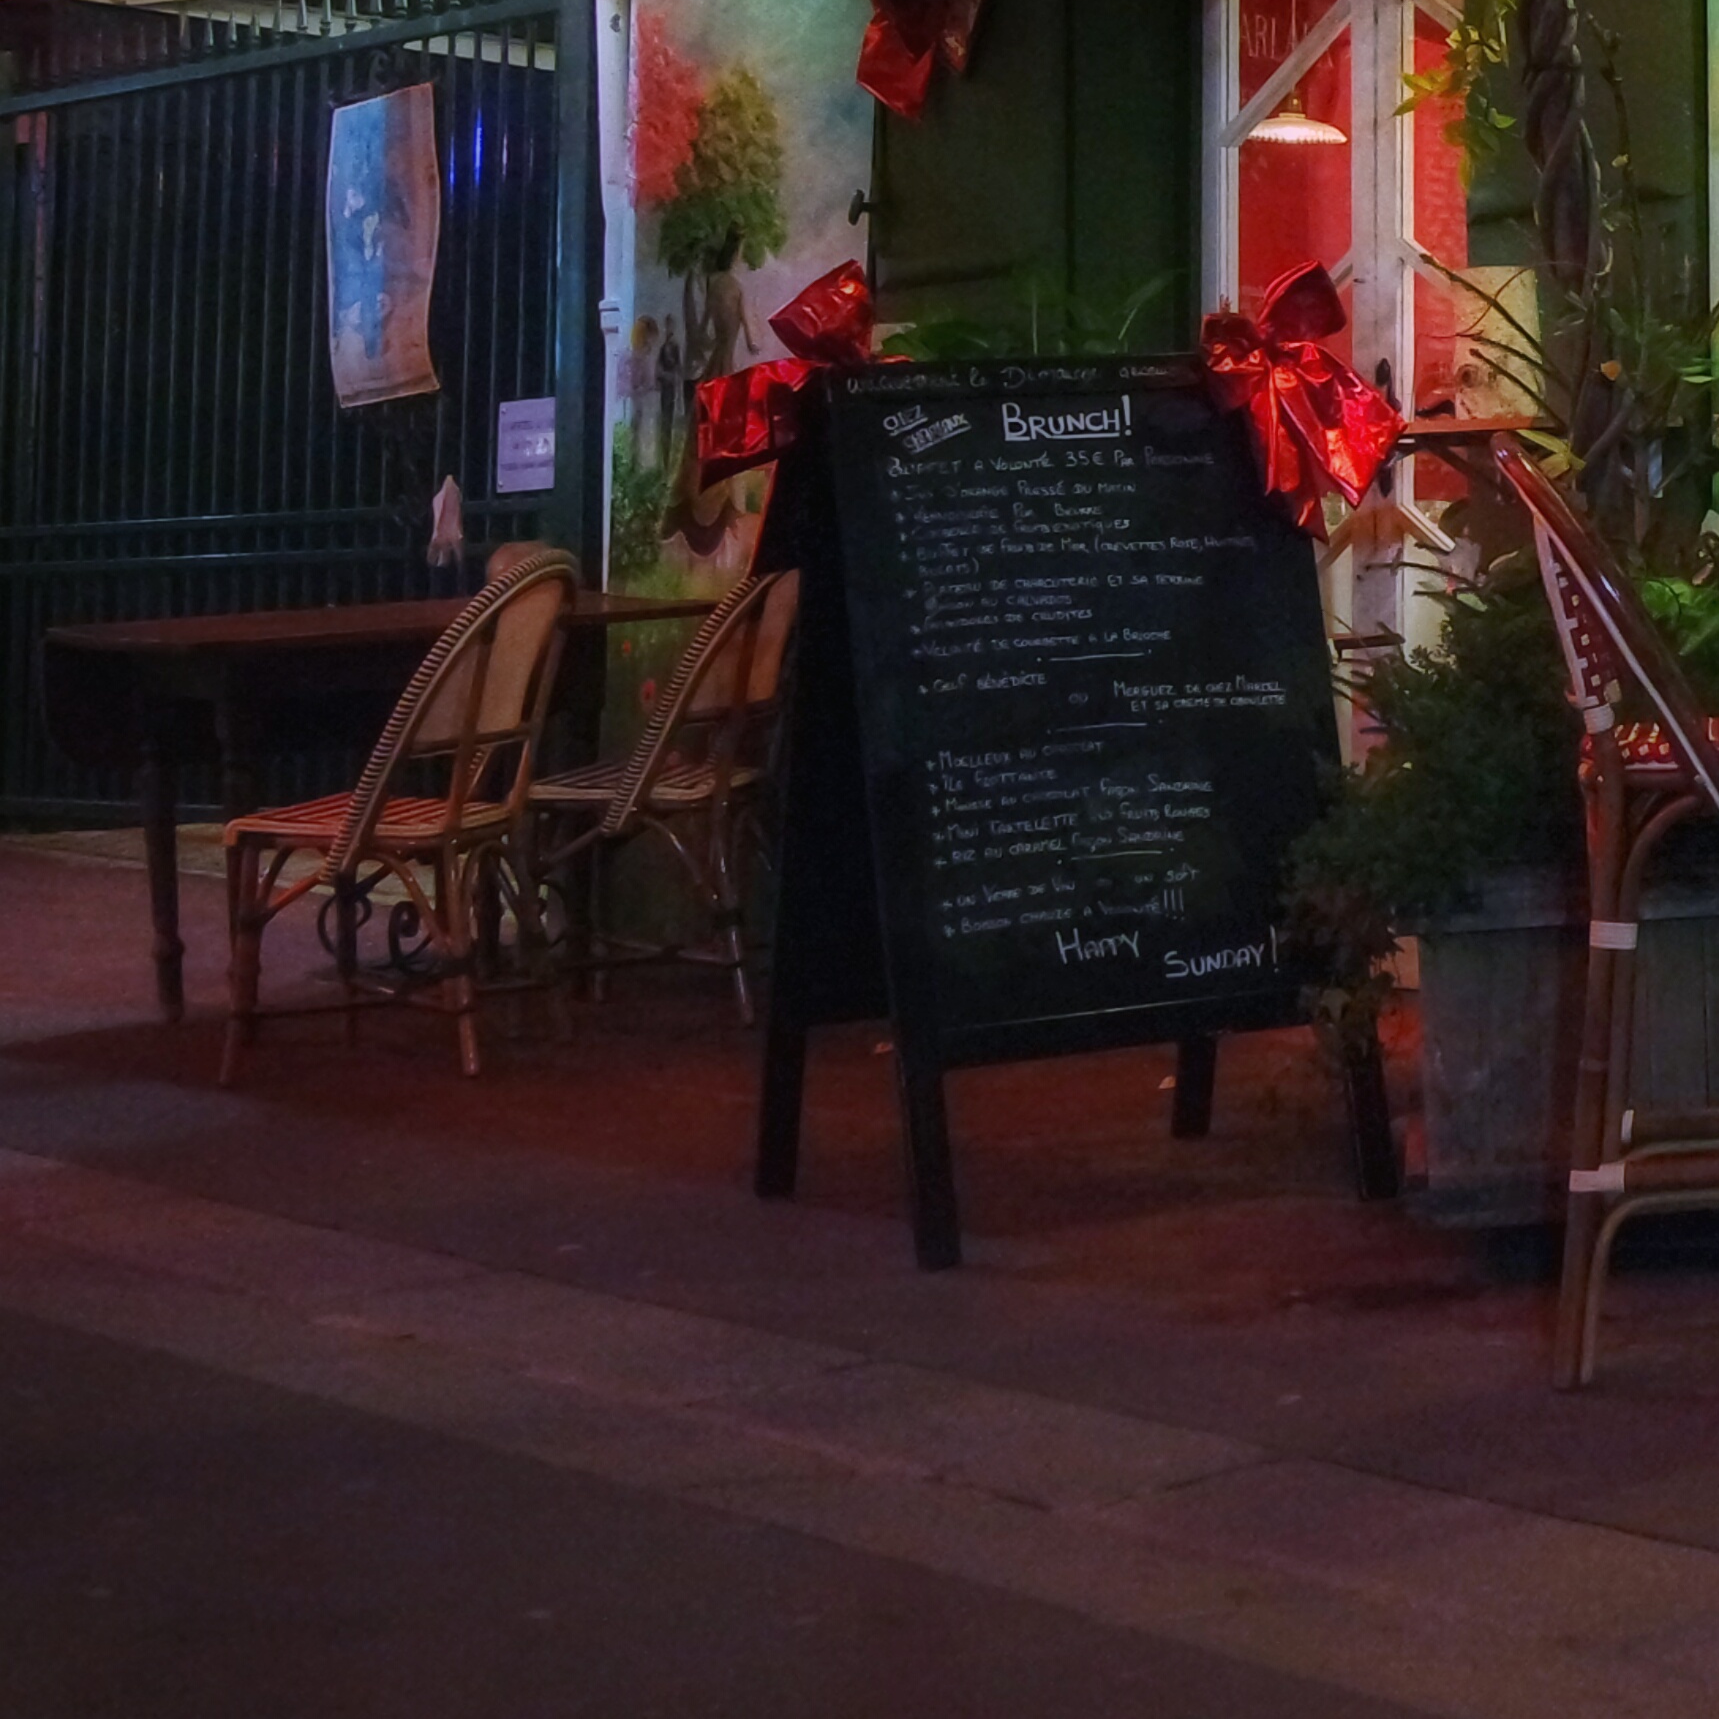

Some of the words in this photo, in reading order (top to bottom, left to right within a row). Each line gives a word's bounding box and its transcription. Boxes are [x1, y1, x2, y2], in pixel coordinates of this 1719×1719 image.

[1001, 394, 1132, 440] BRUNCH!
[1055, 927, 1140, 965] HAPPY
[1164, 924, 1280, 978] SUNDAY!
